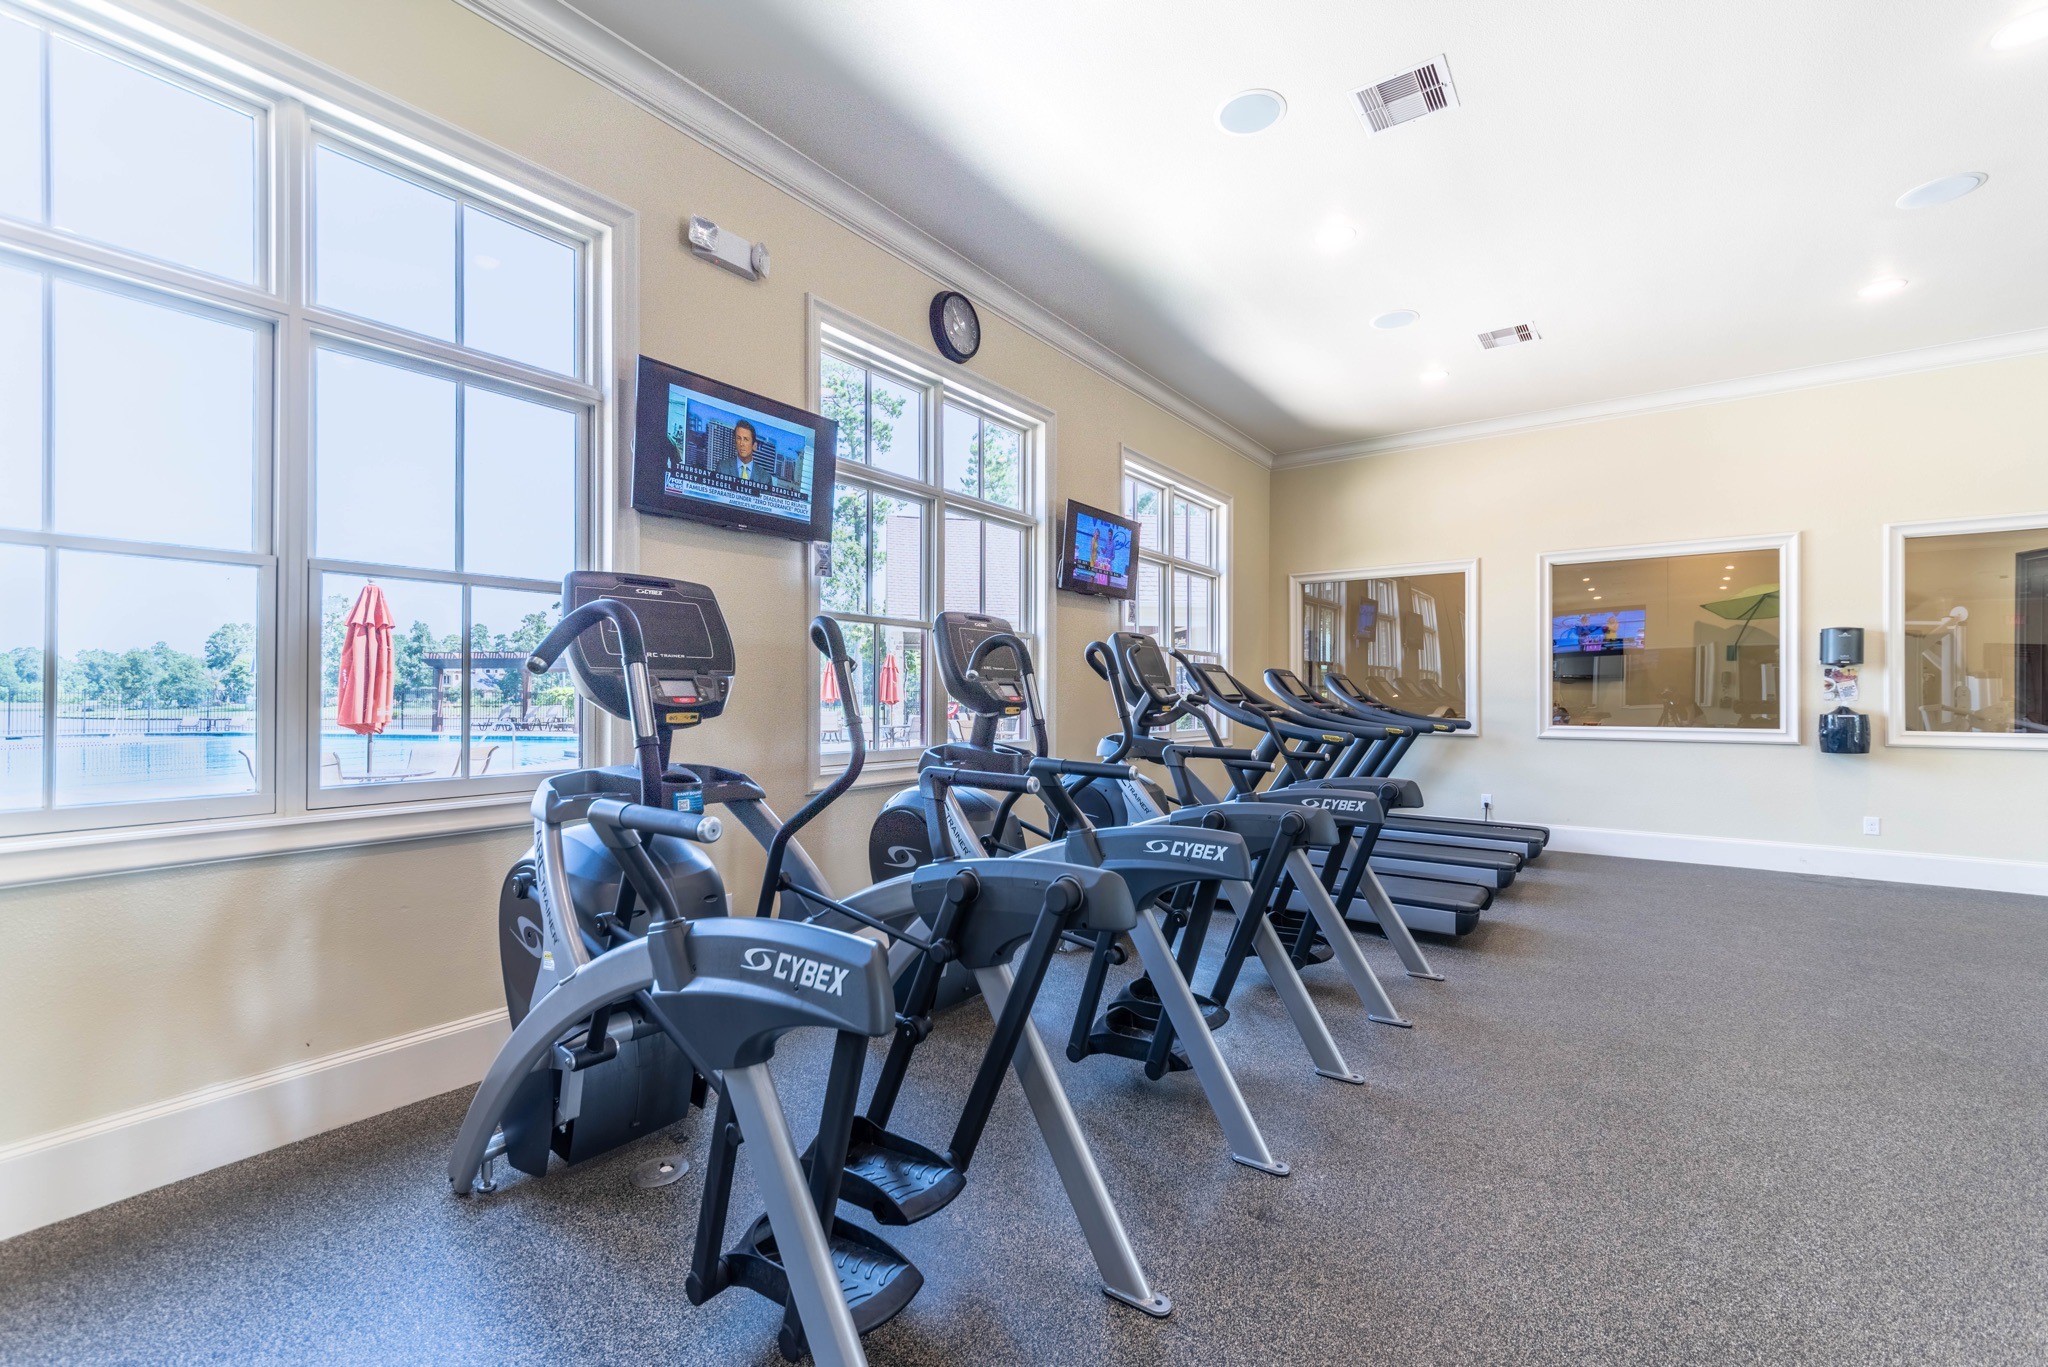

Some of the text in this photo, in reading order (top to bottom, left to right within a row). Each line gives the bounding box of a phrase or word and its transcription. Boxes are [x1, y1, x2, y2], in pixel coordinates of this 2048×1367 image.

[670, 482, 683, 490] NEWS
[675, 471, 752, 494] CASEY STIEGEL LIVE
[676, 463, 712, 476] THURSDAY
[715, 473, 768, 490] COURT-ORDERED
[686, 483, 708, 493] FAMILIES
[708, 488, 735, 499] SEPARATED
[735, 494, 752, 503] UNDER
[794, 507, 809, 515] POLICY
[751, 503, 773, 512] NEWSROOM
[762, 495, 784, 505] DEADLINE
[790, 501, 808, 509] REUNITE
[1127, 783, 1151, 815] TRAINER
[1320, 798, 1367, 812] CYBEX
[946, 813, 970, 856] TRAINER
[536, 829, 546, 882] ARC
[1170, 840, 1229, 862] CYBEX
[540, 872, 559, 946] TRAINER
[773, 952, 850, 997] CYBEX
